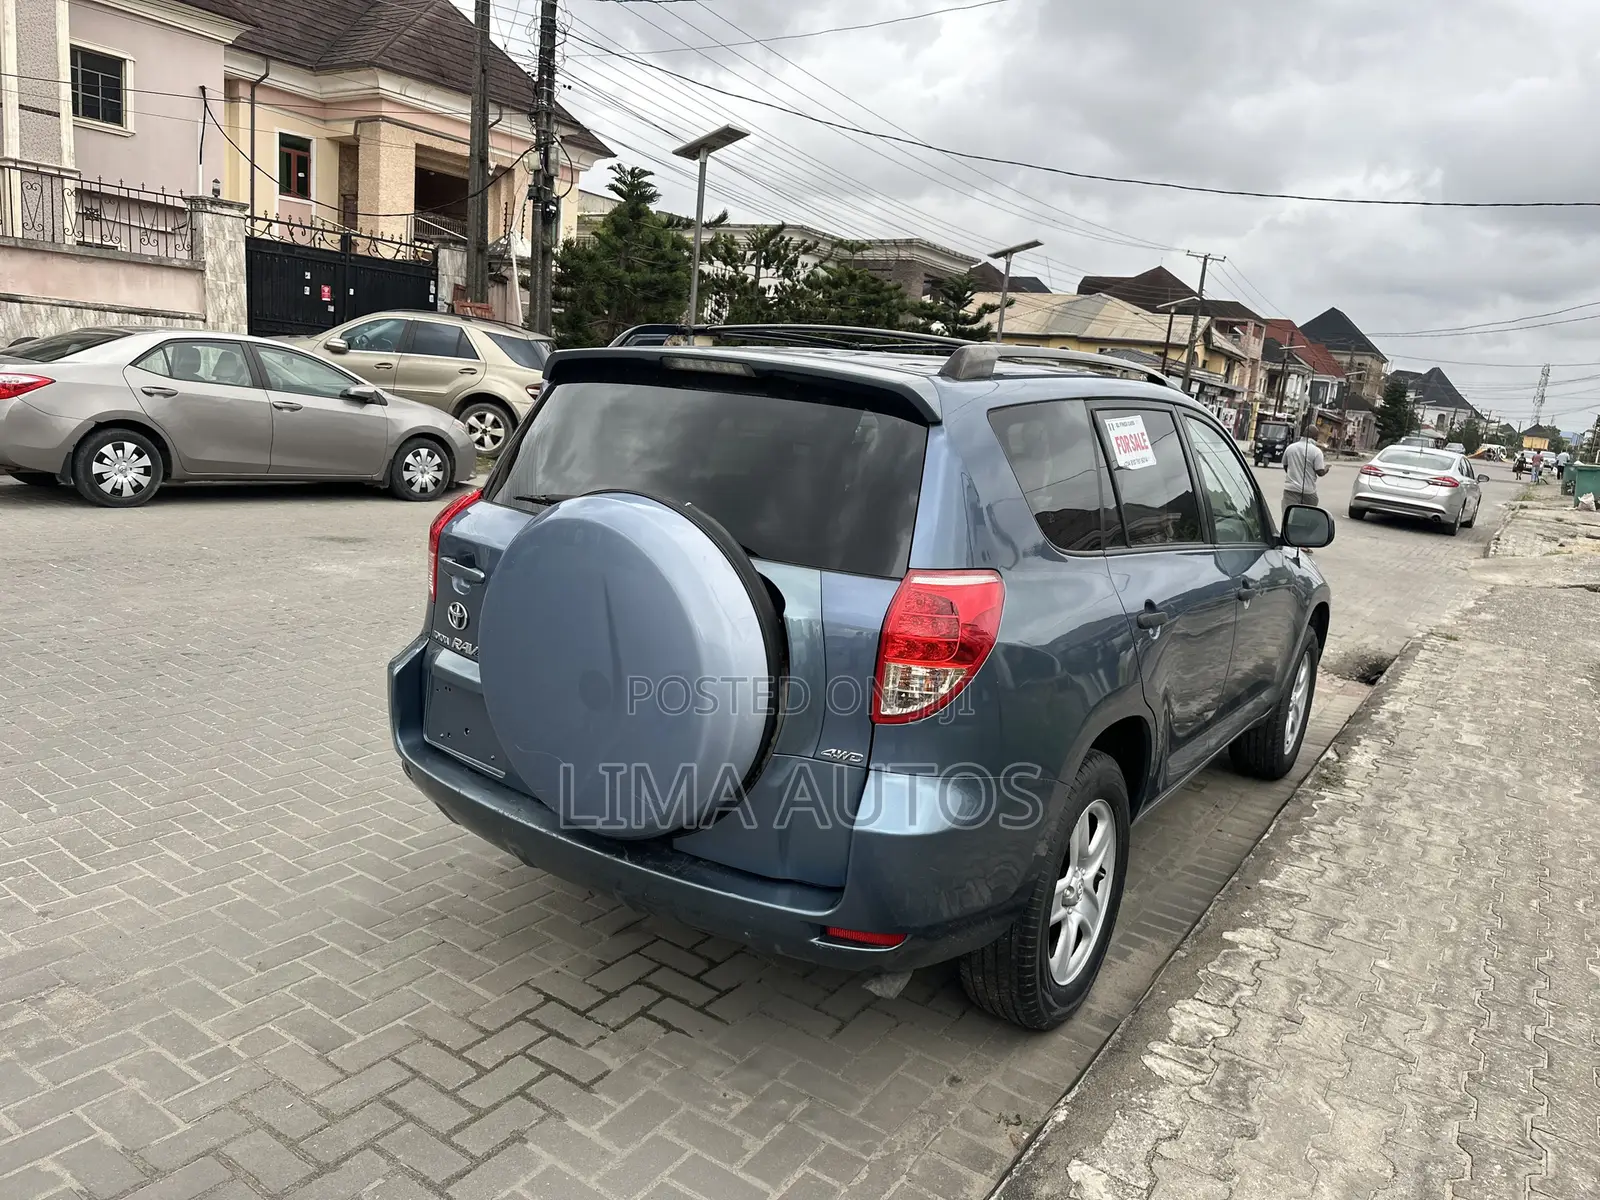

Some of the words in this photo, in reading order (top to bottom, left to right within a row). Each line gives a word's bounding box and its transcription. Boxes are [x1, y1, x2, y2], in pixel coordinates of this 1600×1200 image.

[1114, 435, 1132, 454] FOR
[1129, 432, 1148, 451] SALE
[821, 748, 863, 763] 4WD
